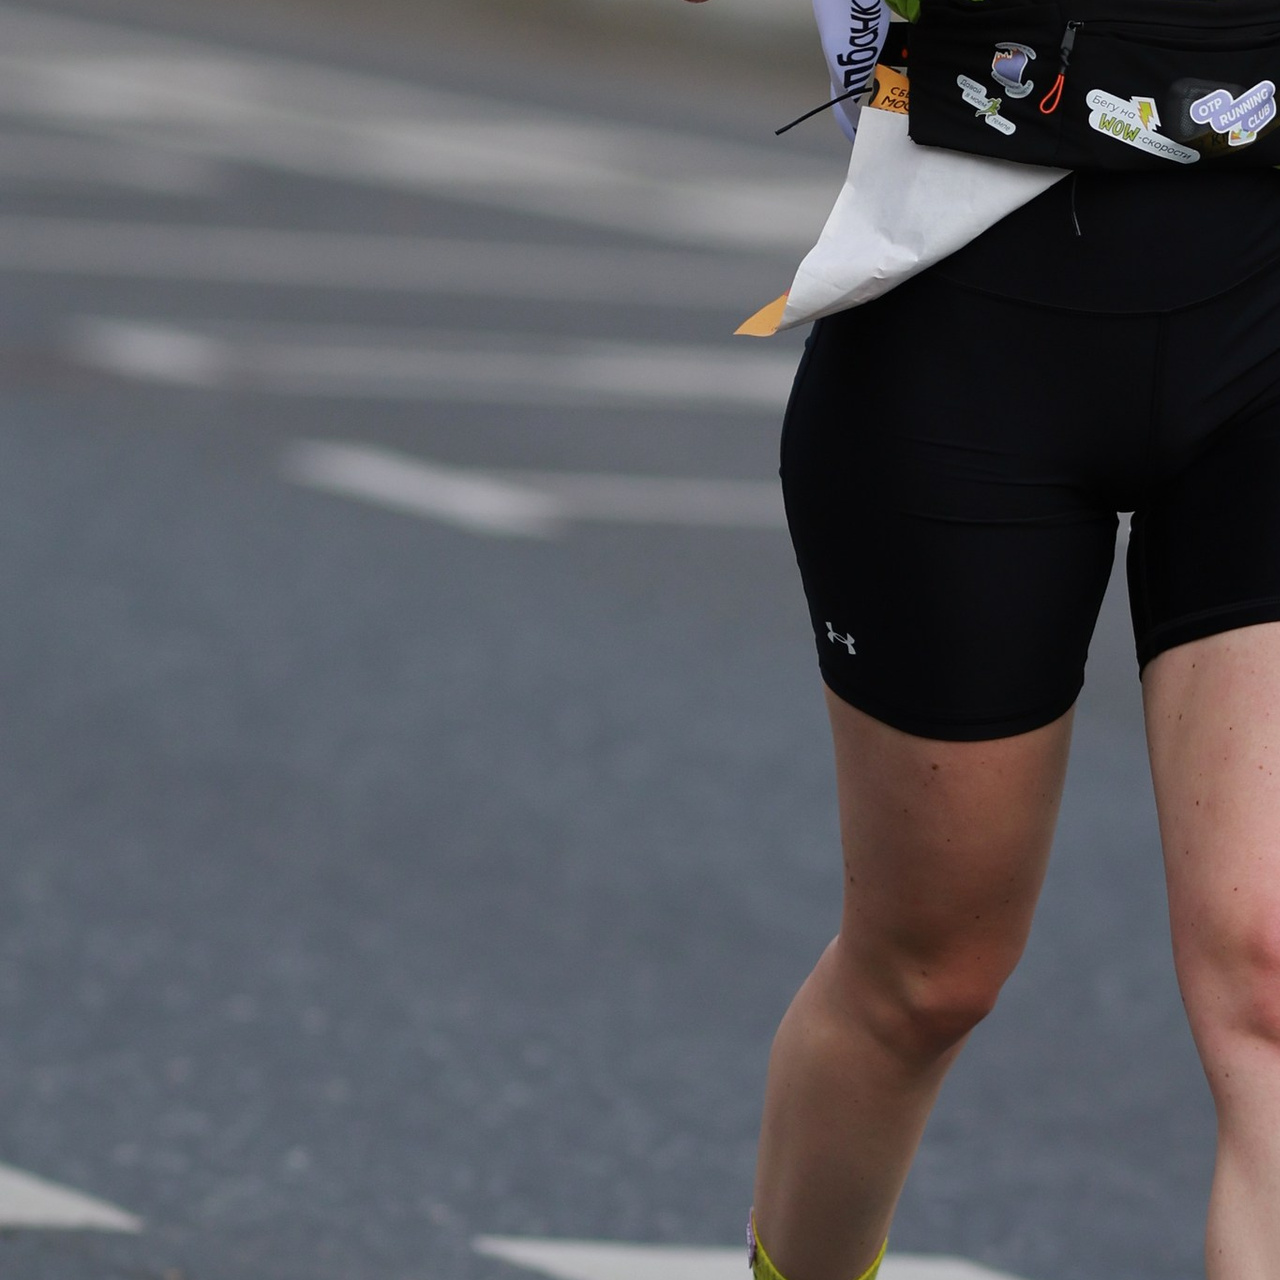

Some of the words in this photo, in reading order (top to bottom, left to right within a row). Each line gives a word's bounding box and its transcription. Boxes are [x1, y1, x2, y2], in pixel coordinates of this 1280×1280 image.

[1092, 95, 1120, 112] Бегу
[1120, 108, 1136, 119] на
[1198, 98, 1222, 116] OTP
[1219, 88, 1269, 126] RUNNING
[1247, 103, 1271, 128] CLUB
